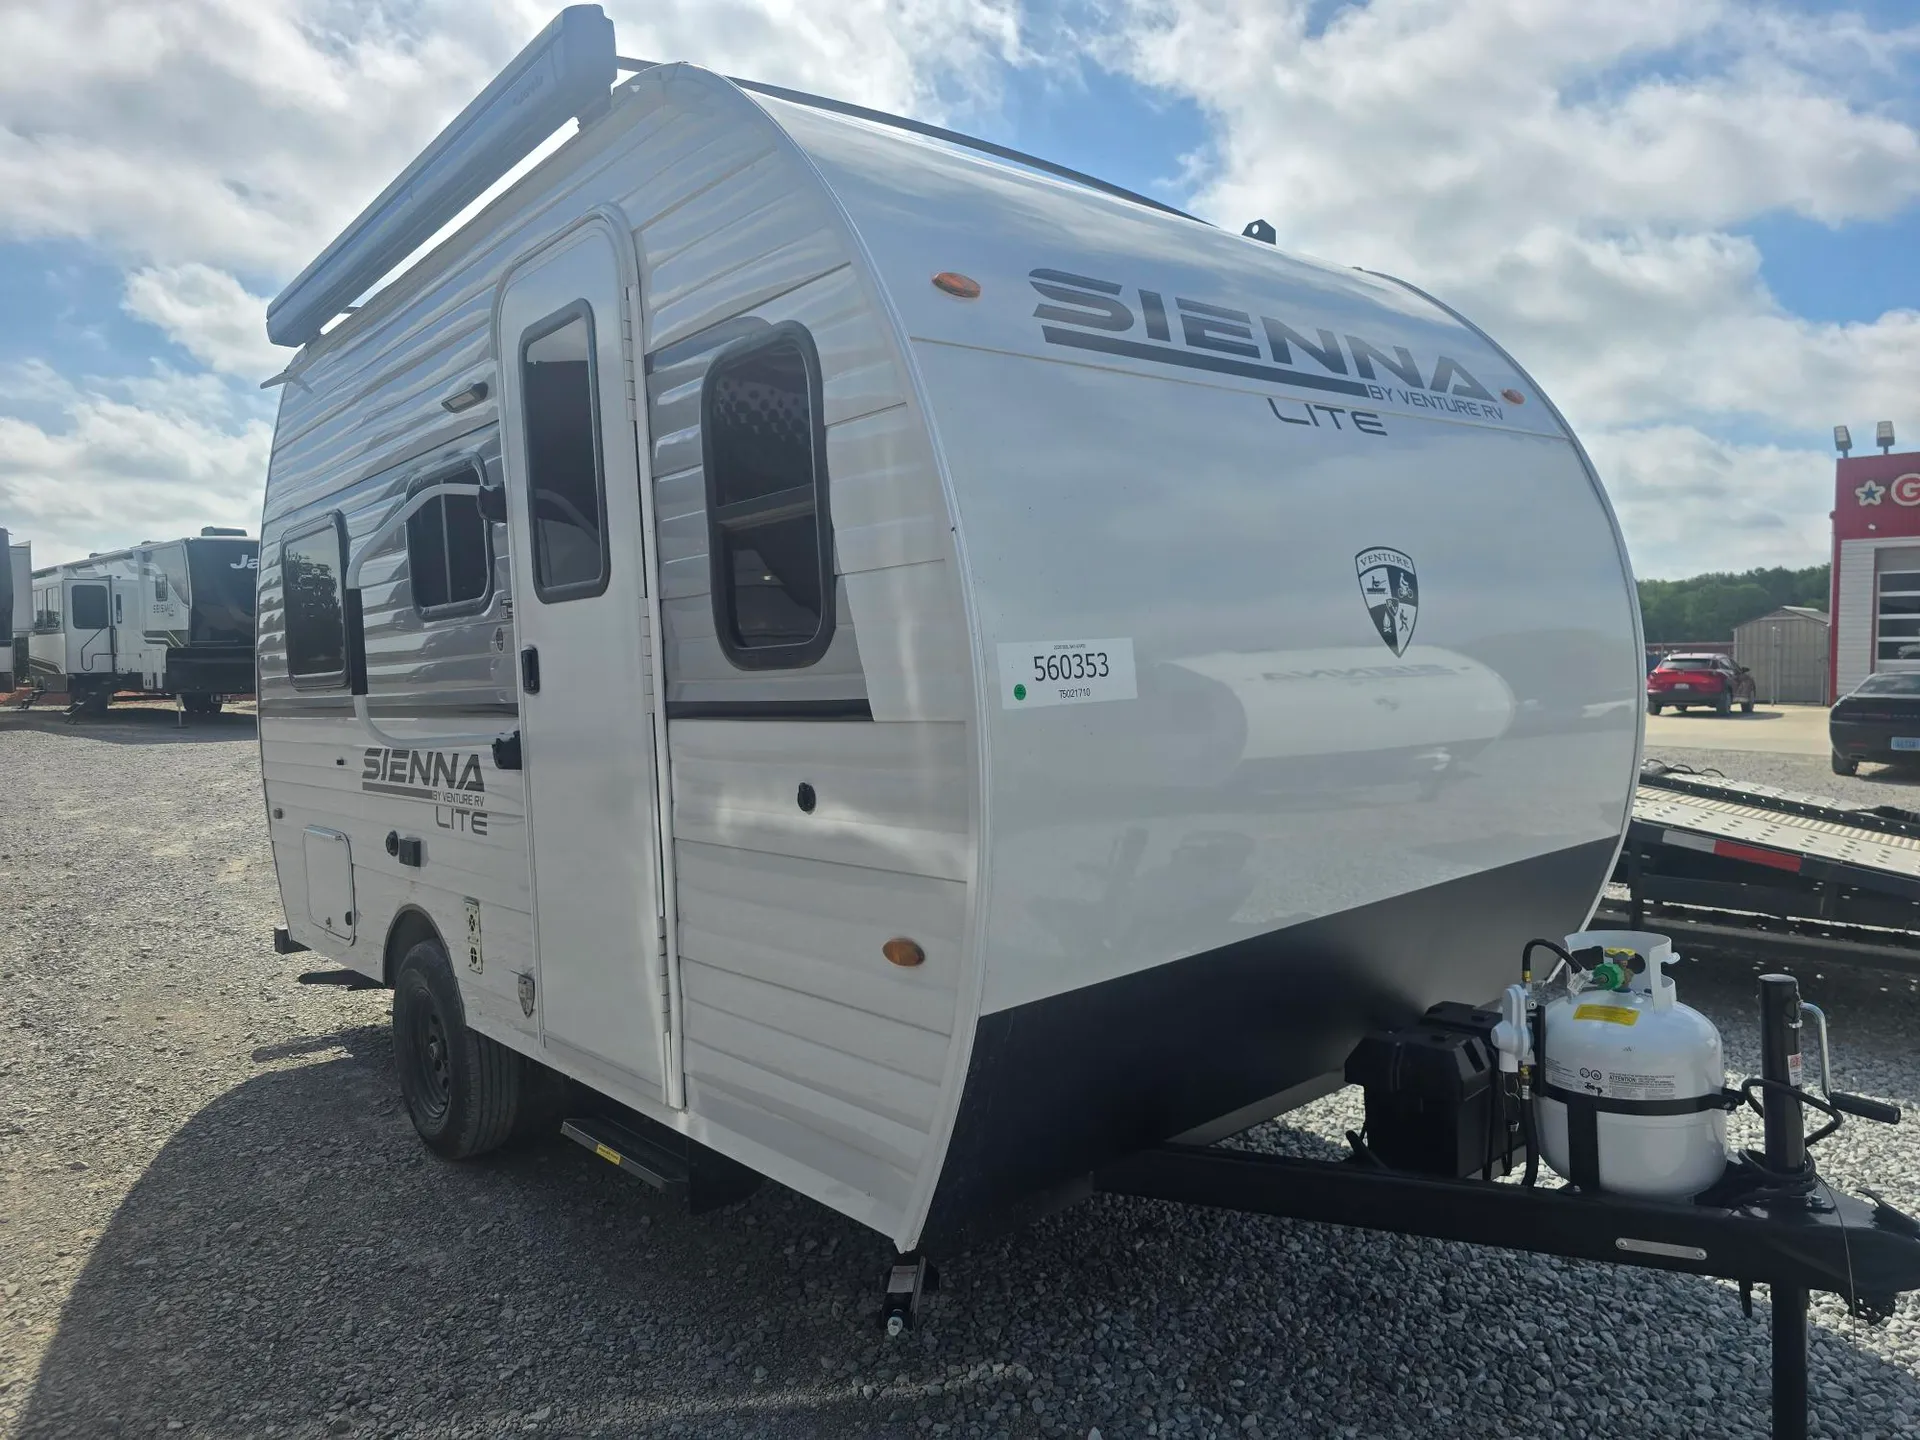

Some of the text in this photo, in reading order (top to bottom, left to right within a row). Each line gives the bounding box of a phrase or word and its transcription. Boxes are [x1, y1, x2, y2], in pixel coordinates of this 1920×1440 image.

[1028, 268, 1498, 402] SIENNA
[1267, 398, 1388, 436] LITE
[1366, 384, 1504, 421] BY VENTURE RV
[1360, 553, 1411, 568] VENTURE
[1033, 652, 1109, 682] 560353
[362, 747, 485, 792] SIENNA
[432, 790, 485, 807] BY VENTURE RV
[436, 805, 488, 836] LITE
[1609, 1074, 1636, 1083] ATTENTION
